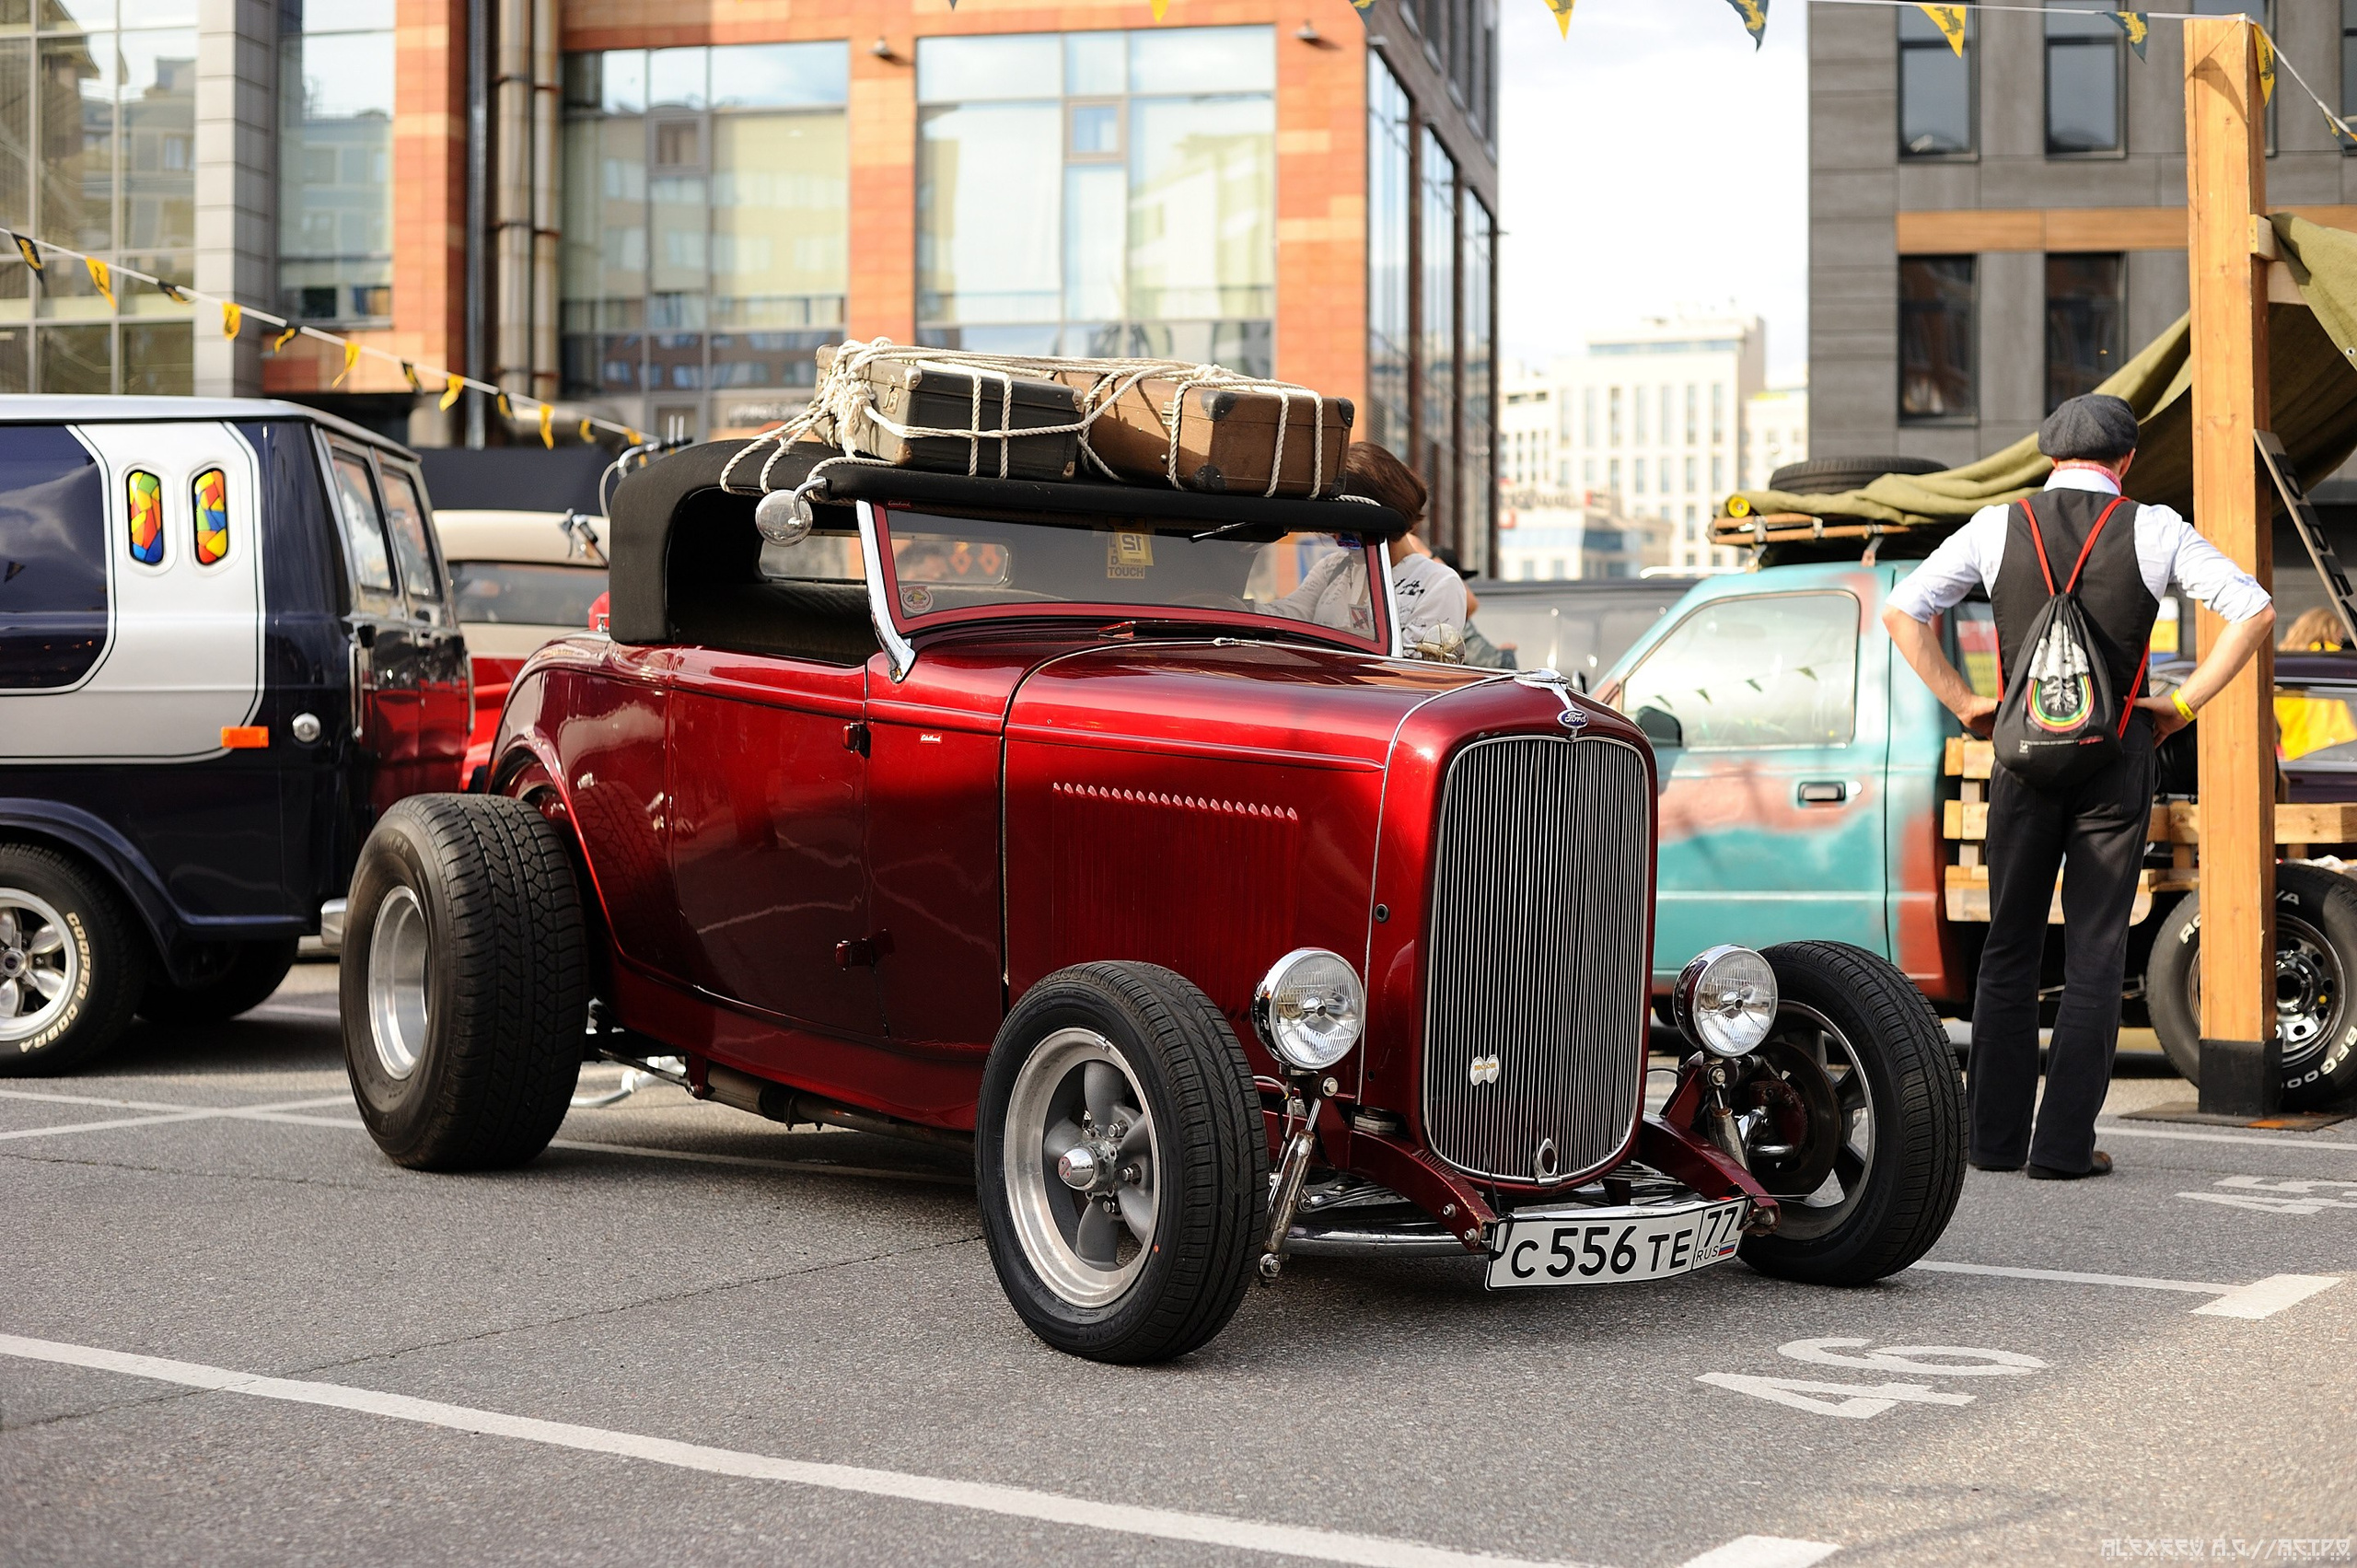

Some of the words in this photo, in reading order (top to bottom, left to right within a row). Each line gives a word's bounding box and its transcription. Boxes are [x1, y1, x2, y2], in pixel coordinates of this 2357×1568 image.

[1109, 566, 1144, 577] TOUCH
[1564, 712, 1587, 723] Ford
[66, 912, 90, 1001] COOPER
[19, 1003, 78, 1053] COBRA
[2282, 1025, 2357, 1088] BFGOO
[1704, 1206, 1738, 1248] 77
[1696, 1245, 1719, 1262] RUS
[1694, 1337, 2048, 1419] 46
